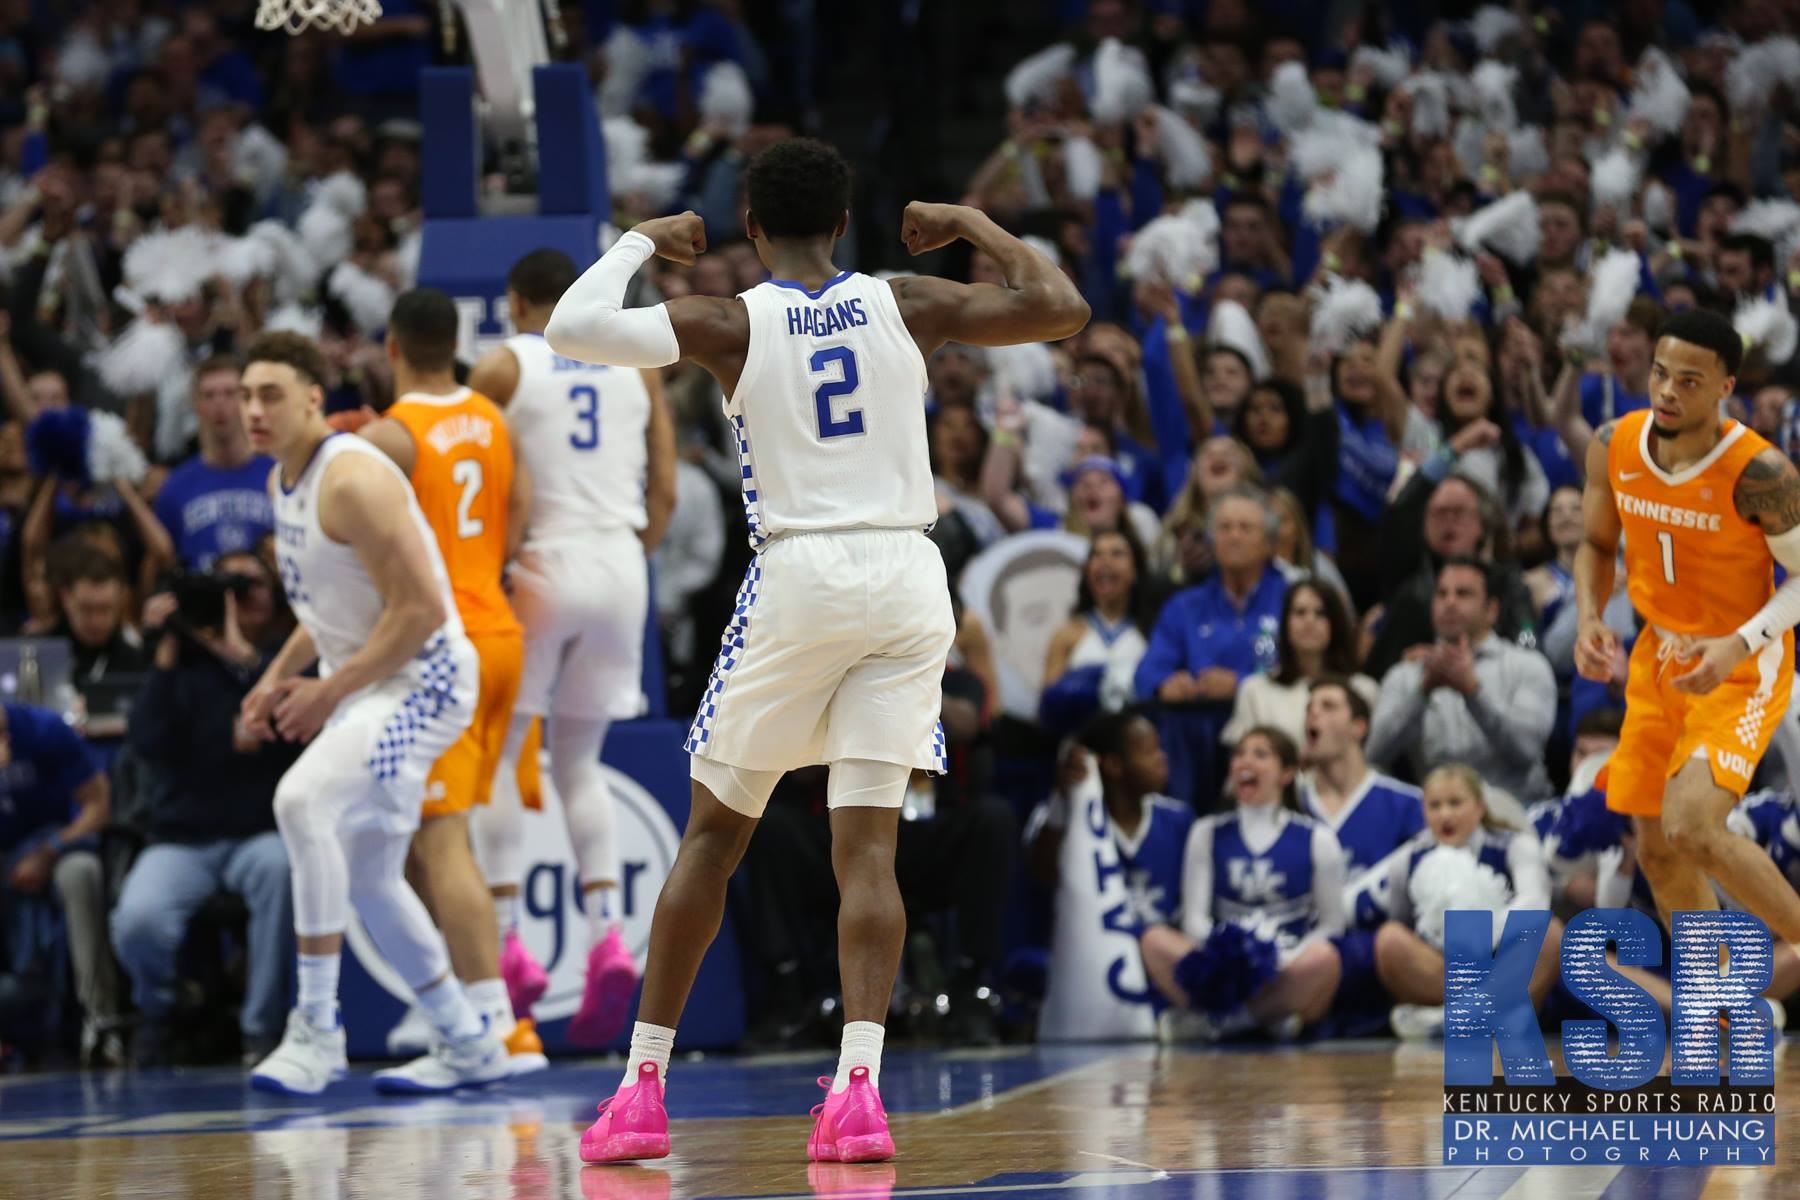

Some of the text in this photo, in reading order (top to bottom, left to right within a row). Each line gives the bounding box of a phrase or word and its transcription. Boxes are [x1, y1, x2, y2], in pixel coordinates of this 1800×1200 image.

[787, 298, 867, 337] HAGANS
[569, 385, 599, 450] 3
[809, 345, 866, 440] 2
[453, 458, 483, 539] 2
[1615, 490, 1721, 532] TENNESSEE
[1657, 530, 1676, 585] 1
